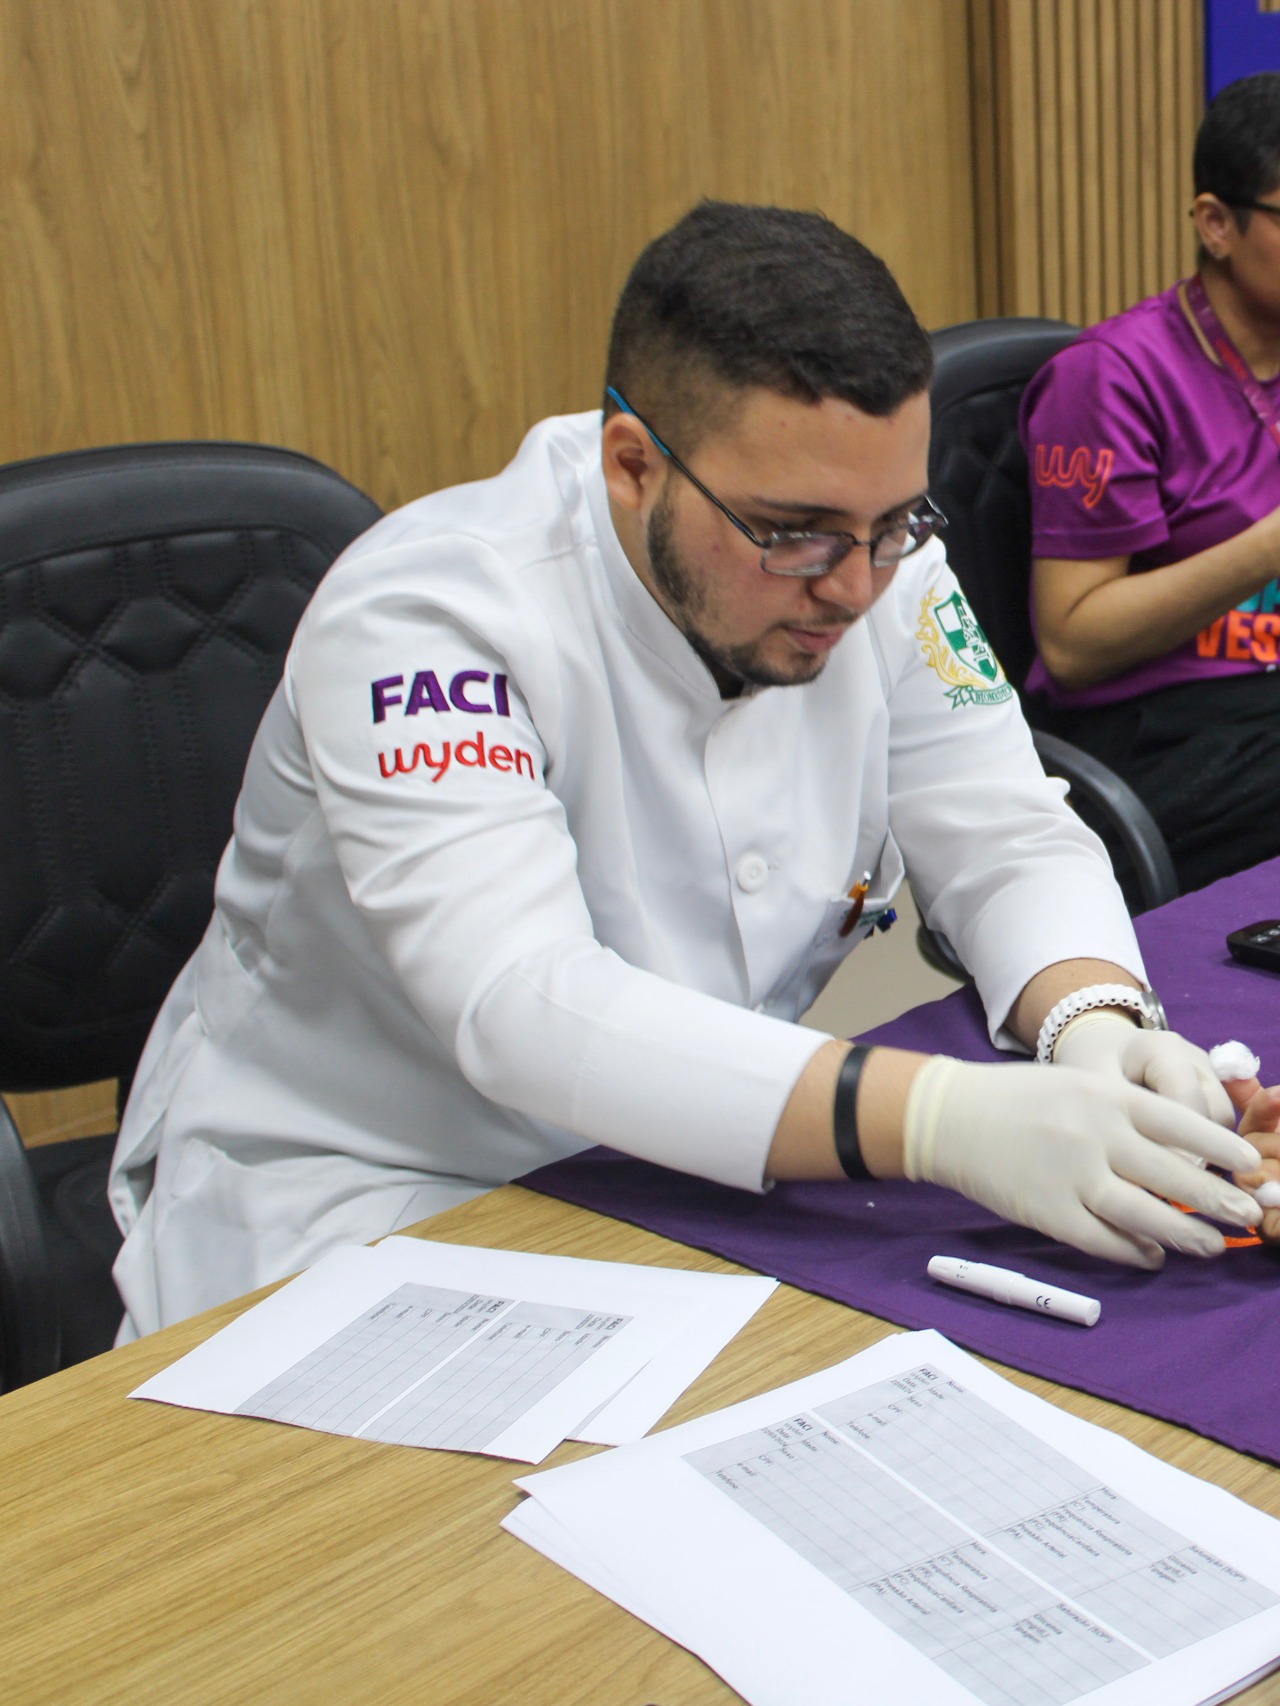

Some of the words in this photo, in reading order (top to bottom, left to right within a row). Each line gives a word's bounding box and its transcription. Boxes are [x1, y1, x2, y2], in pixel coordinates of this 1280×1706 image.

[371, 669, 511, 724] FACI
[378, 731, 535, 783] wyden
[919, 1367, 938, 1381] FACI
[793, 1417, 814, 1432] FACI
[1081, 1494, 1121, 1525] Temperatura
[1042, 1541, 1069, 1560] Arterial
[950, 1550, 989, 1581] Temperatura
[906, 1598, 933, 1616] Arterial
